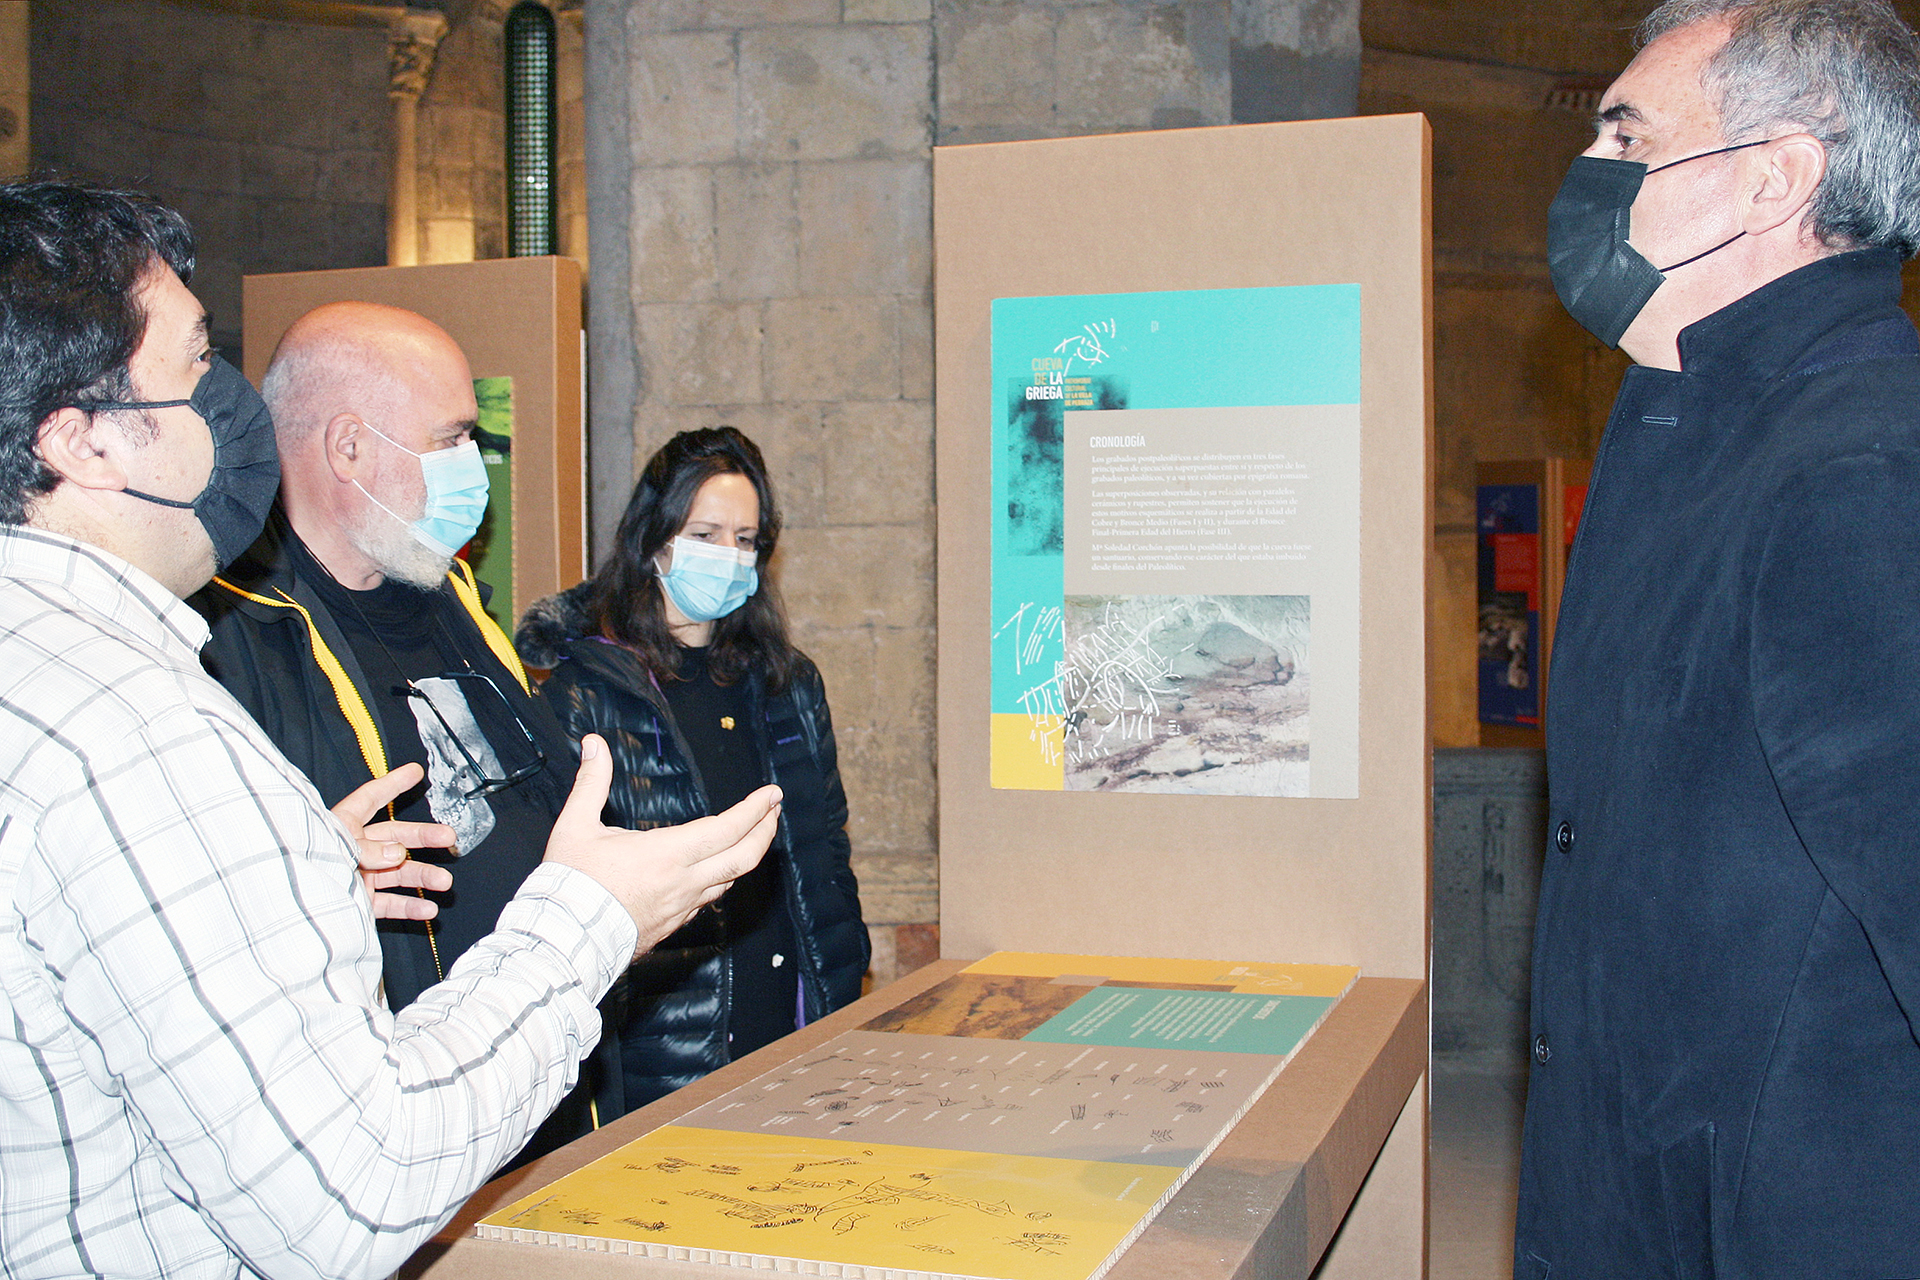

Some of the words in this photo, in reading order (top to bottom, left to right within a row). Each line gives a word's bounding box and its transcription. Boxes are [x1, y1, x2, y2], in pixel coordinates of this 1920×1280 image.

[1032, 358, 1063, 371] CUEVA
[1034, 372, 1047, 385] DE
[1049, 372, 1063, 385] LA
[1026, 386, 1063, 400] GRIEGA
[1090, 433, 1146, 448] CRONOLOGÍA
[1092, 455, 1104, 463] Los
[1105, 455, 1137, 464] grabados
[1138, 454, 1192, 464] postpaleolíticos
[1201, 453, 1241, 463] distribuyen
[1253, 452, 1266, 460] tres
[1268, 452, 1285, 460] fases
[1092, 464, 1129, 474] principales
[1130, 464, 1139, 472] de
[1140, 464, 1174, 474] ejecución
[1175, 463, 1219, 473] superpuestas
[1221, 463, 1239, 471] entre
[1254, 462, 1283, 472] respecto
[1092, 474, 1122, 484] grabados
[1200, 473, 1232, 481] cubiertas
[1234, 474, 1246, 482] por
[1263, 487, 1295, 497] paralelos
[1092, 499, 1126, 507] cerámicos
[1168, 498, 1199, 508] permiten
[1201, 498, 1230, 506] sostener
[1254, 497, 1288, 507] ejecución
[1289, 497, 1298, 505] de
[1092, 509, 1108, 517] estos
[1110, 509, 1137, 517] motivos
[1139, 508, 1184, 518] esquemáticos
[1195, 508, 1218, 516] realiza
[1225, 508, 1245, 517] partir
[1265, 507, 1283, 515] Edad
[1285, 507, 1296, 515] del
[1120, 518, 1144, 526] Bronce
[1146, 518, 1168, 526] Medio
[1260, 517, 1285, 525] Bronce
[1141, 528, 1158, 536] Edad
[1160, 528, 1171, 536] del
[1172, 528, 1196, 536] Hierro
[1104, 543, 1131, 551] Soledad
[1164, 543, 1188, 552] apunta
[1198, 543, 1237, 552] posibilidad
[1248, 544, 1261, 552] que
[1263, 542, 1270, 550] la
[1293, 542, 1312, 550] fuese
[1138, 553, 1182, 561] conservando
[1196, 553, 1223, 561] carácter
[1225, 553, 1236, 561] del
